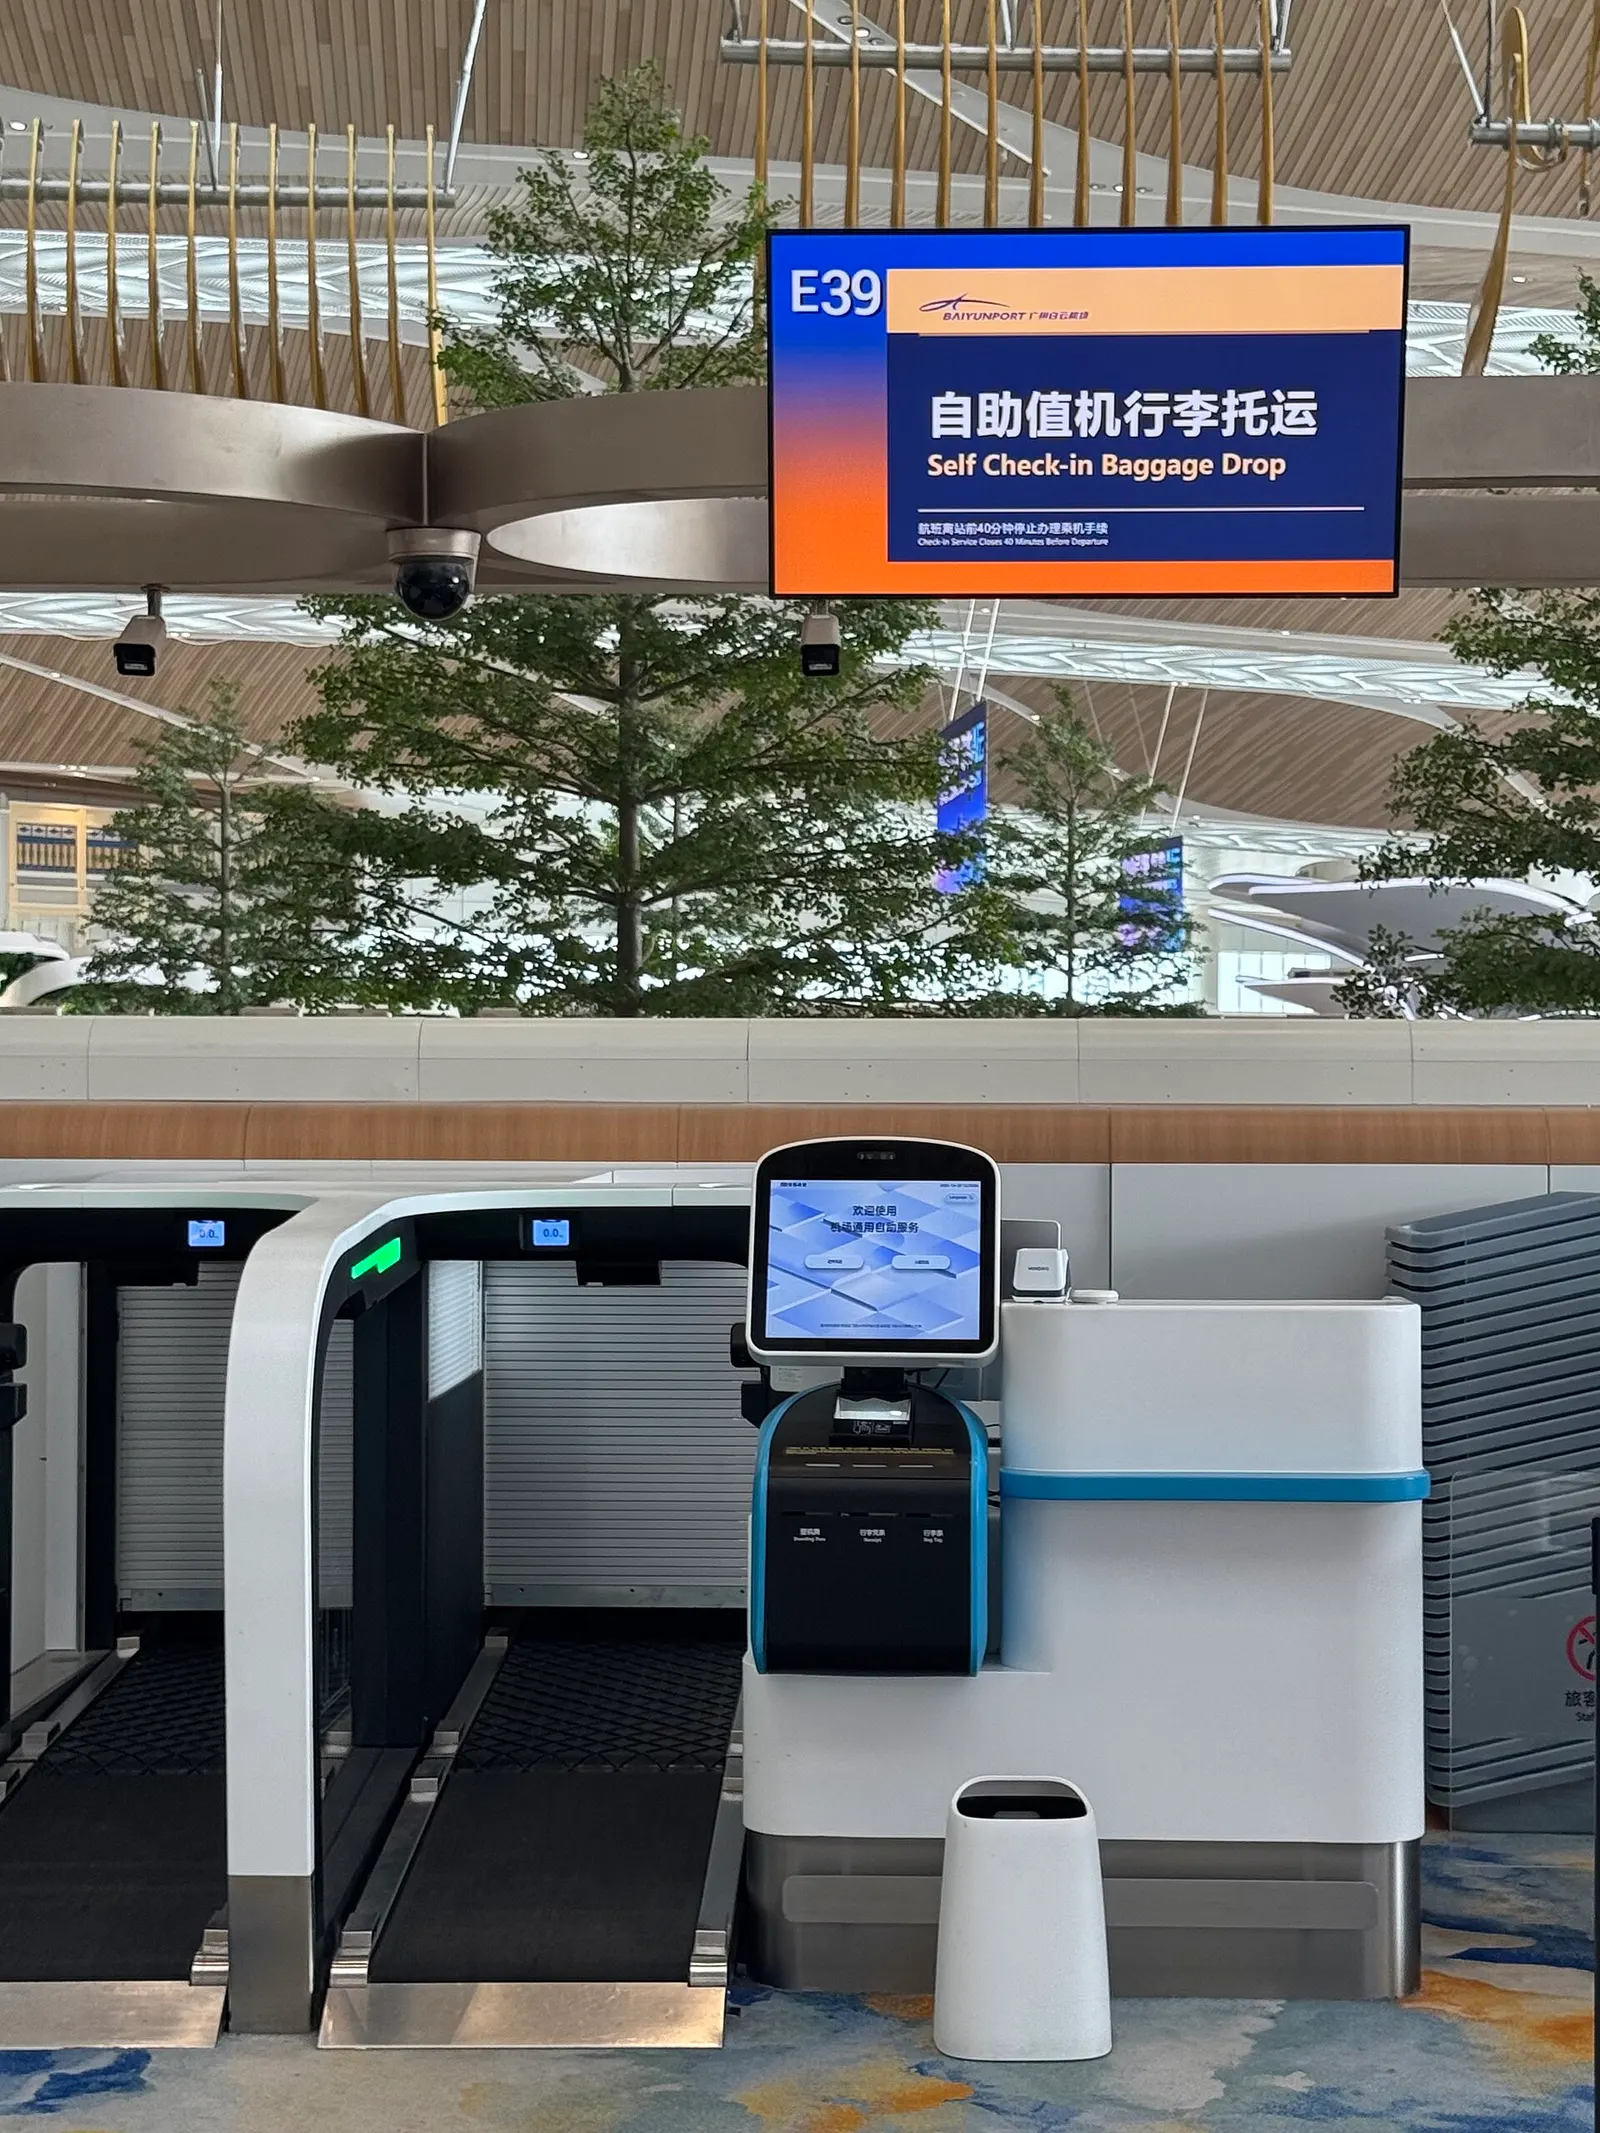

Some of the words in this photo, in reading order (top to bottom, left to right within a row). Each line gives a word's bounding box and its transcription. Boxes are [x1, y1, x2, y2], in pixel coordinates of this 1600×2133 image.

[791, 269, 881, 316] E39
[943, 311, 1026, 321] BAIYUNPORT
[931, 390, 1318, 438] 自助值机行李托运
[927, 453, 977, 476] Self
[983, 453, 1093, 476] Check-in
[1101, 453, 1214, 482] Baggage
[1221, 452, 1286, 481] Drop
[951, 538, 978, 546] Service
[1004, 538, 1014, 546] 40
[1015, 538, 1045, 546] Minutes
[1071, 537, 1109, 547] Departure
[852, 1205, 897, 1217] 欢迎使用
